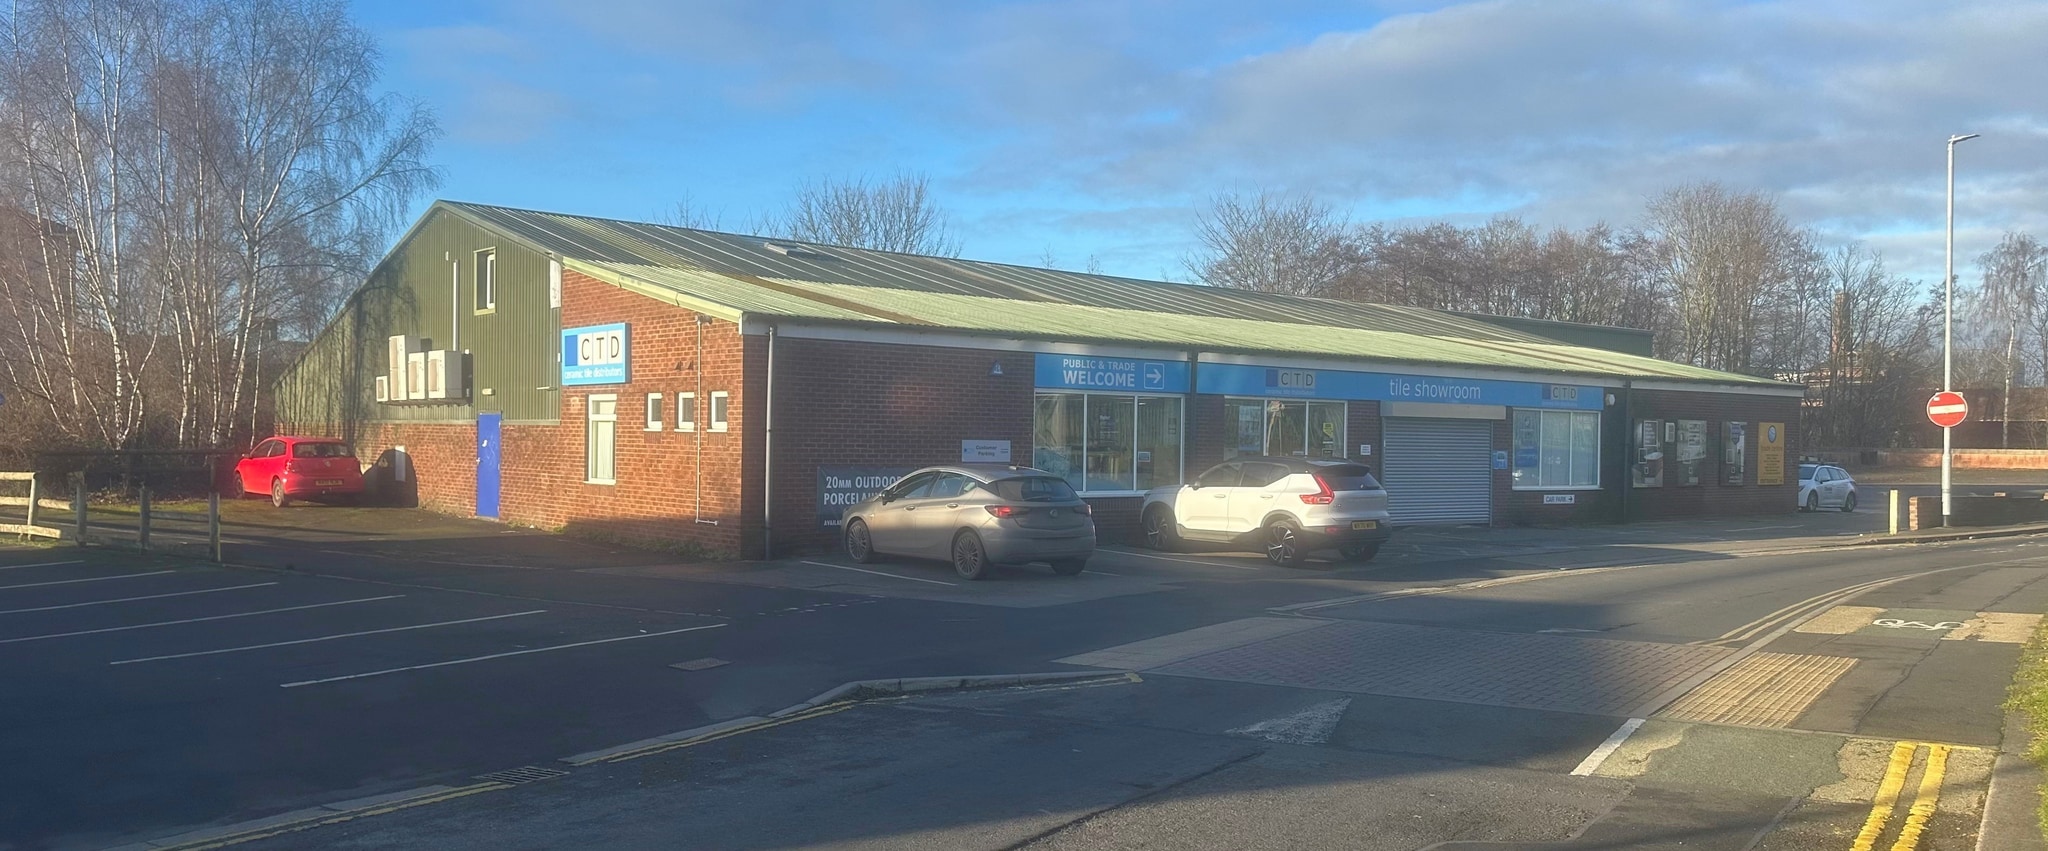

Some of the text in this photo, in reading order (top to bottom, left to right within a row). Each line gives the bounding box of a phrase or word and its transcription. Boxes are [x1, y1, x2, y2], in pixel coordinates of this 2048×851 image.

[581, 335, 620, 361] CTD
[1063, 358, 1136, 371] PUBLIC & TRADE
[1063, 370, 1136, 387] WELCOME
[1281, 372, 1314, 386] CTD
[1389, 379, 1481, 399] tile showroom
[1552, 386, 1577, 399] CTD
[855, 476, 901, 489] OUTDOO
